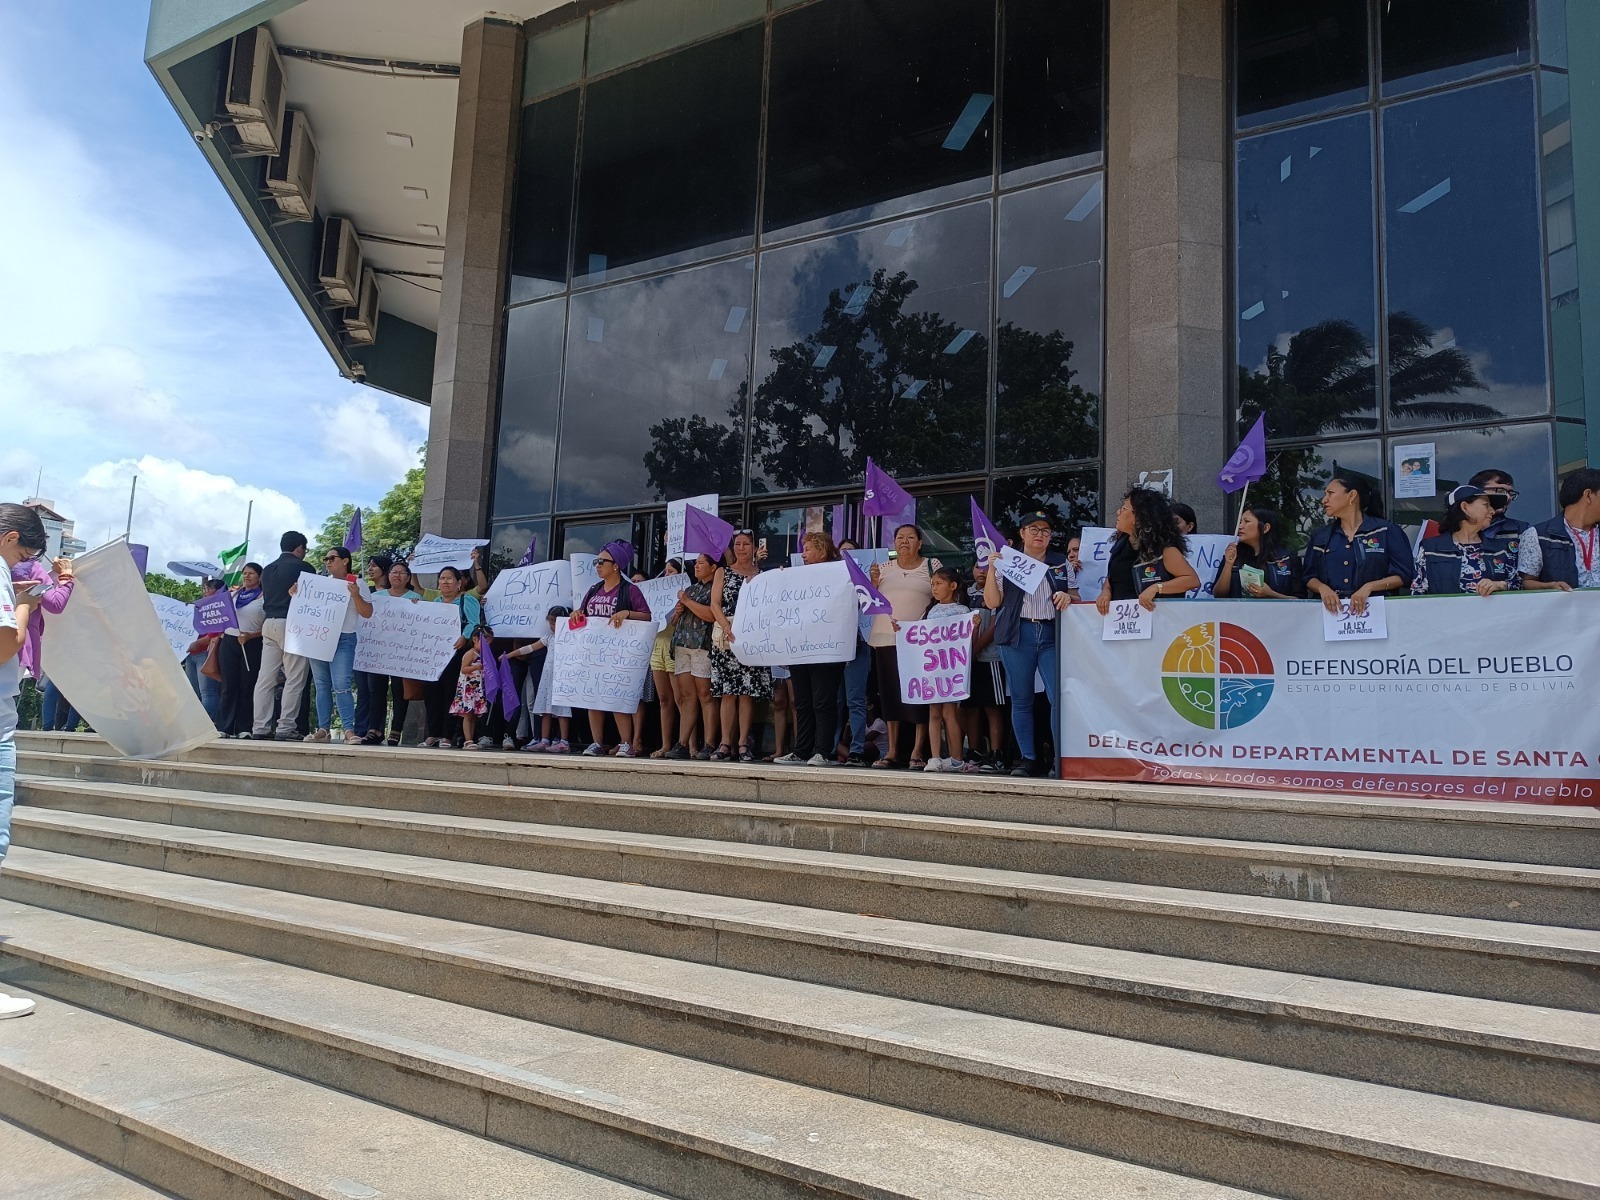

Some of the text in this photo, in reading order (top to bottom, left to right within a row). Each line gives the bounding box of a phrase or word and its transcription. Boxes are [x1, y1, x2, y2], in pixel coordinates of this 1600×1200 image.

[1005, 556, 1036, 575] 348
[504, 568, 560, 597] BASTA
[298, 579, 347, 606] Ni un paso
[780, 585, 831, 602] excusas
[199, 601, 225, 612] JUSTICIA
[202, 610, 221, 619] PARA
[297, 603, 321, 617] atrás
[1113, 603, 1140, 622] 348
[200, 616, 229, 626] TODXS
[1119, 621, 1136, 630] LA LEY
[1344, 621, 1366, 630] LA LEY
[305, 624, 330, 642] 348
[924, 645, 967, 671] SIN
[1286, 654, 1573, 676] DEFENSORÍA DEL PUEBLO
[1287, 681, 1576, 693] ESTADO PLURINACIONAL DE BOLIVIA
[1088, 734, 1223, 758] DELEGACIÓN
[1233, 745, 1443, 765] DEPARTAMENTAL
[1452, 750, 1487, 766] DE
[1496, 750, 1589, 768] SANTA
[1151, 766, 1593, 799] Todas y todos somos defensores del pueblo
